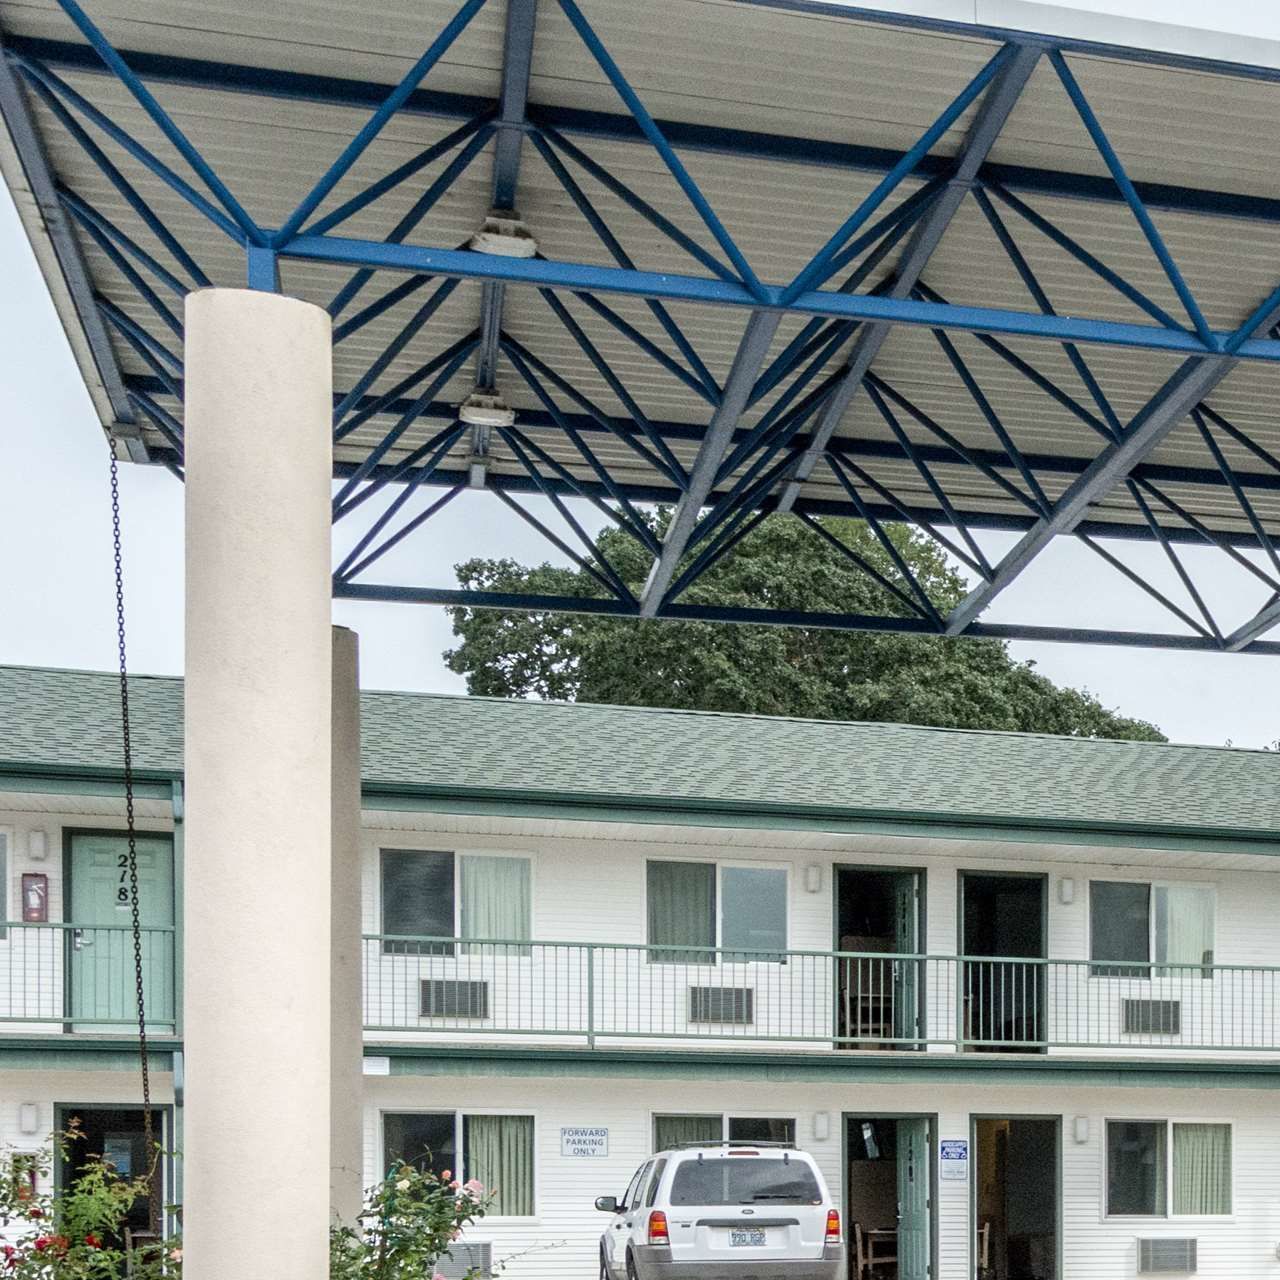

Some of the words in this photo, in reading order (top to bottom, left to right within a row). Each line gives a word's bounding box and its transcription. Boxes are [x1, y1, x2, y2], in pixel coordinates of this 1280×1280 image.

[117, 854, 129, 901] 218
[563, 1129, 607, 1137] FORWARD
[566, 1138, 604, 1146] PARKING
[573, 1147, 597, 1155] ONLY
